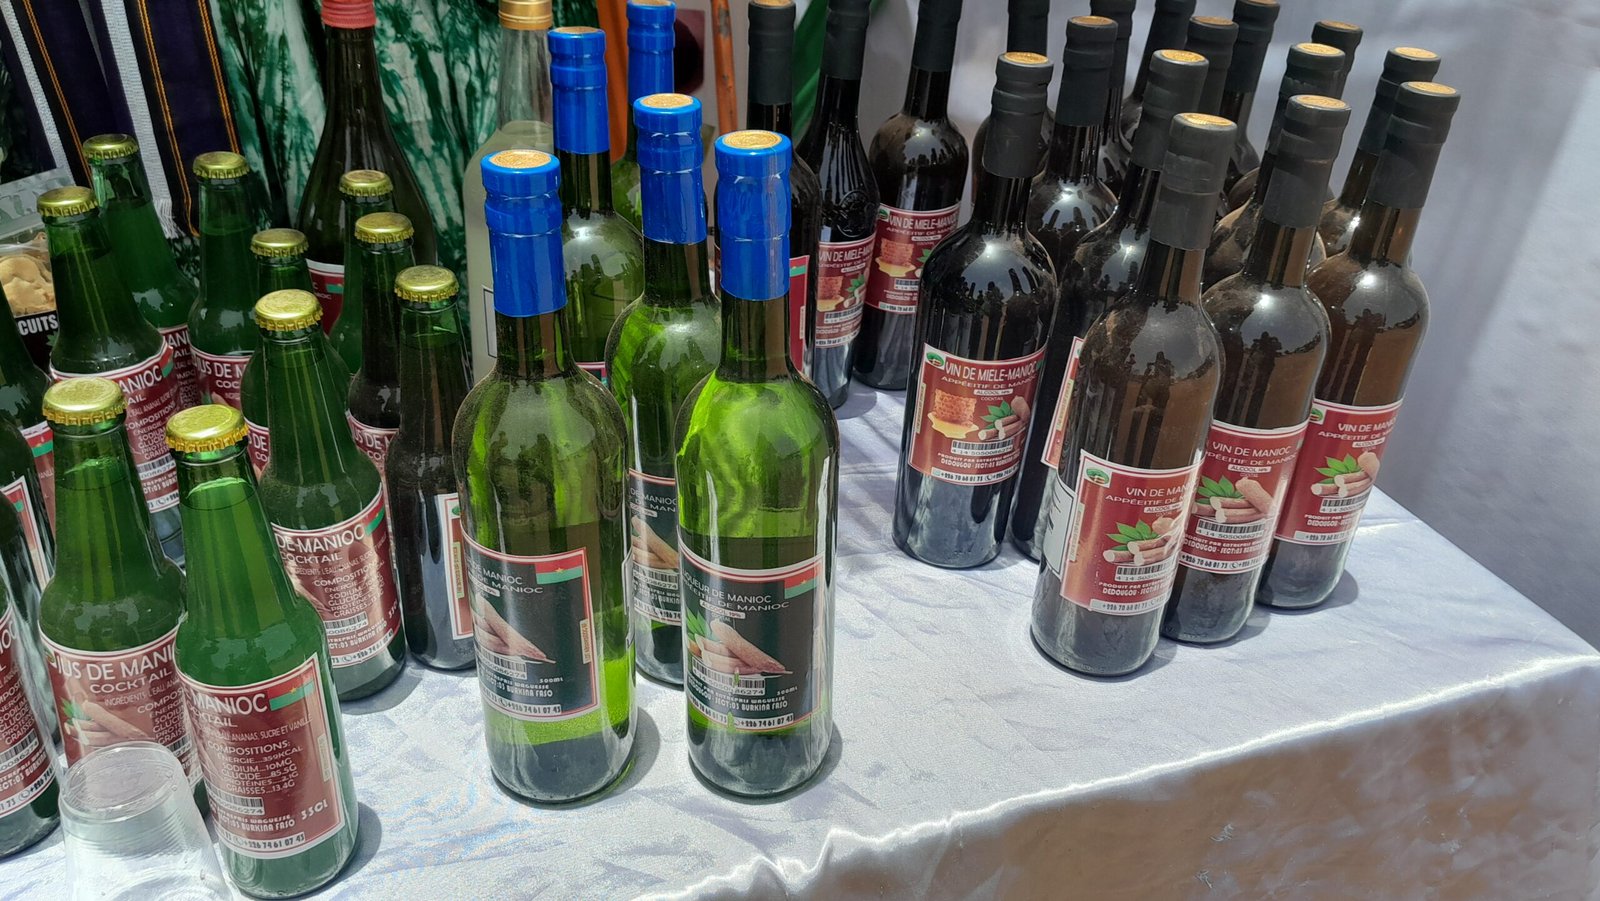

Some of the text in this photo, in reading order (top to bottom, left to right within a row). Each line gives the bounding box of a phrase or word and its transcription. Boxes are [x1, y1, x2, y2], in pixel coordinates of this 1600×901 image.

[214, 362, 232, 378] DE
[946, 362, 961, 377] VIN
[963, 366, 976, 380] DE
[118, 366, 162, 394] ANIOC
[1338, 423, 1372, 432] VIN DE
[253, 434, 268, 451] DE
[1212, 442, 1291, 457] VIN DE MANIOC
[1126, 487, 1146, 497] VIN
[650, 504, 676, 512] MAN
[483, 568, 523, 585] MANIOC
[492, 581, 543, 593] MANIOC
[683, 570, 771, 604] IQUEUR DE MANIOC
[737, 602, 790, 611] MANIOC
[0, 620, 16, 654] IOC
[86, 663, 115, 680] DE
[121, 644, 173, 677] MANI
[90, 668, 172, 693] COCKTAIL
[192, 692, 268, 715] MANIOC
[281, 726, 288, 734] ET
[208, 740, 290, 756] COMPOSITIONS:
